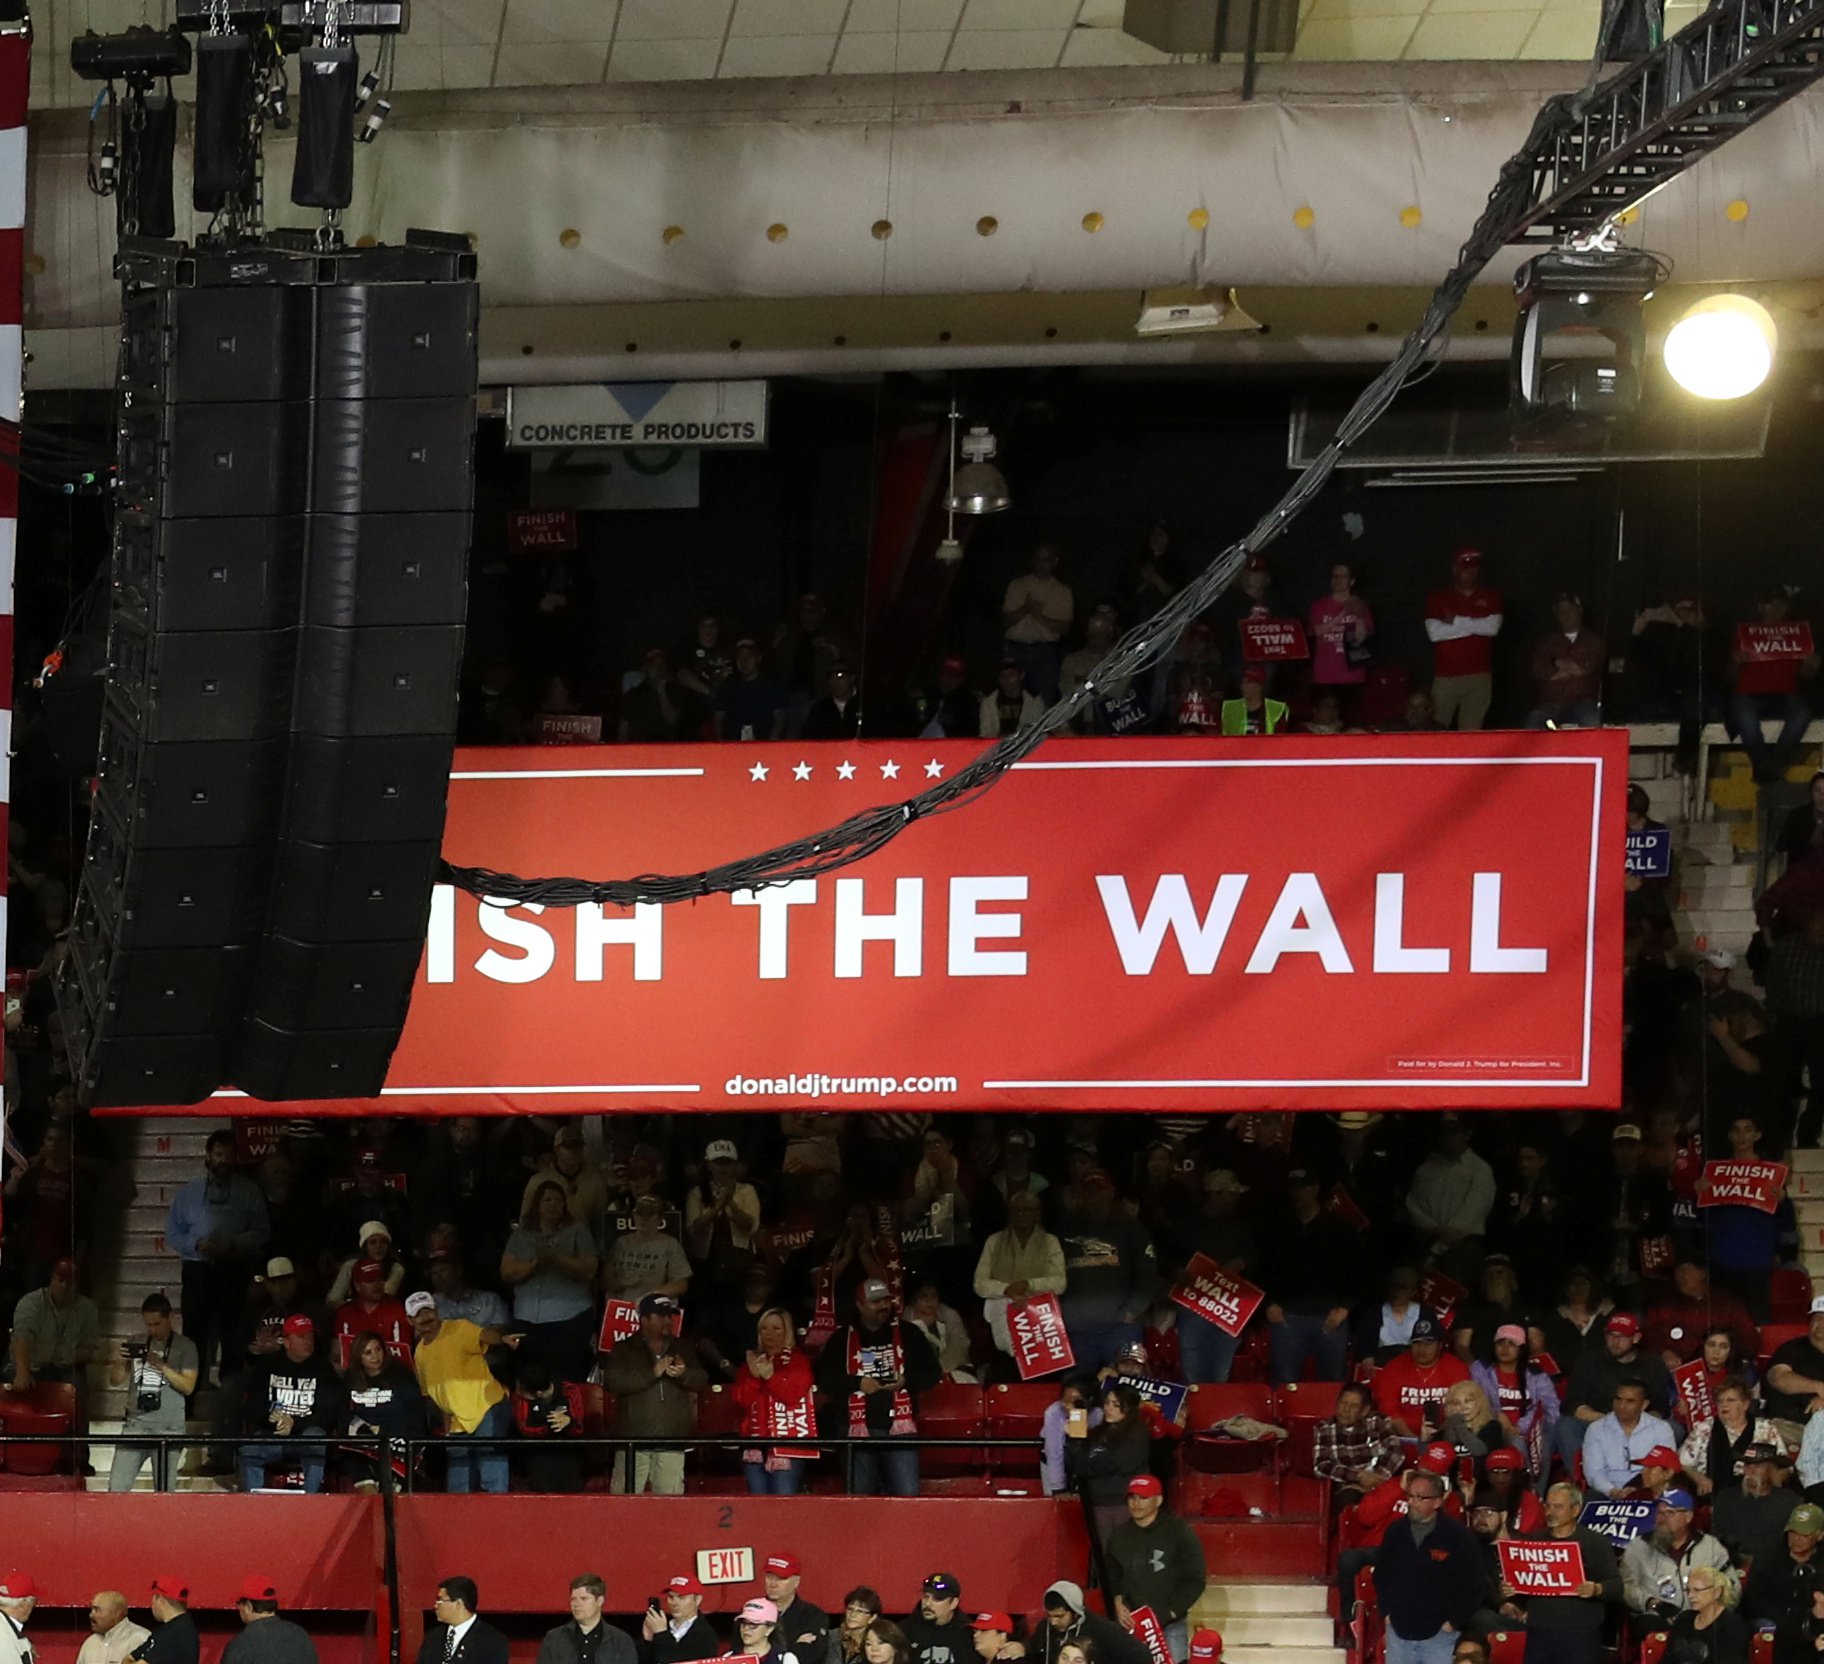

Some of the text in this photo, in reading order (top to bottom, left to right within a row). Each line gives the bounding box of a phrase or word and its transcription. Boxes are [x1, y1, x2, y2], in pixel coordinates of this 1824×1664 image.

[520, 423, 755, 441] CONCRETE PRODUCTS
[1752, 641, 1803, 654] WALL
[1625, 858, 1658, 871] ALL
[427, 872, 1550, 984] ISH THE WALL
[725, 1074, 958, 1098] donaldjtrump.com
[1714, 1165, 1777, 1180] FINISH
[1711, 1184, 1767, 1202] WALL
[1193, 1276, 1242, 1313] WALL
[1198, 1296, 1240, 1326] 88022
[1015, 1311, 1042, 1367] WALL
[1034, 1302, 1065, 1362] FINISH
[718, 1505, 733, 1529] 2
[1595, 1504, 1651, 1518] BUILD
[1609, 1517, 1629, 1525] THE
[1508, 1546, 1569, 1564] FINISH
[709, 1550, 745, 1580] EXIT
[1528, 1563, 1549, 1572] THE
[1514, 1570, 1572, 1587] WALL
